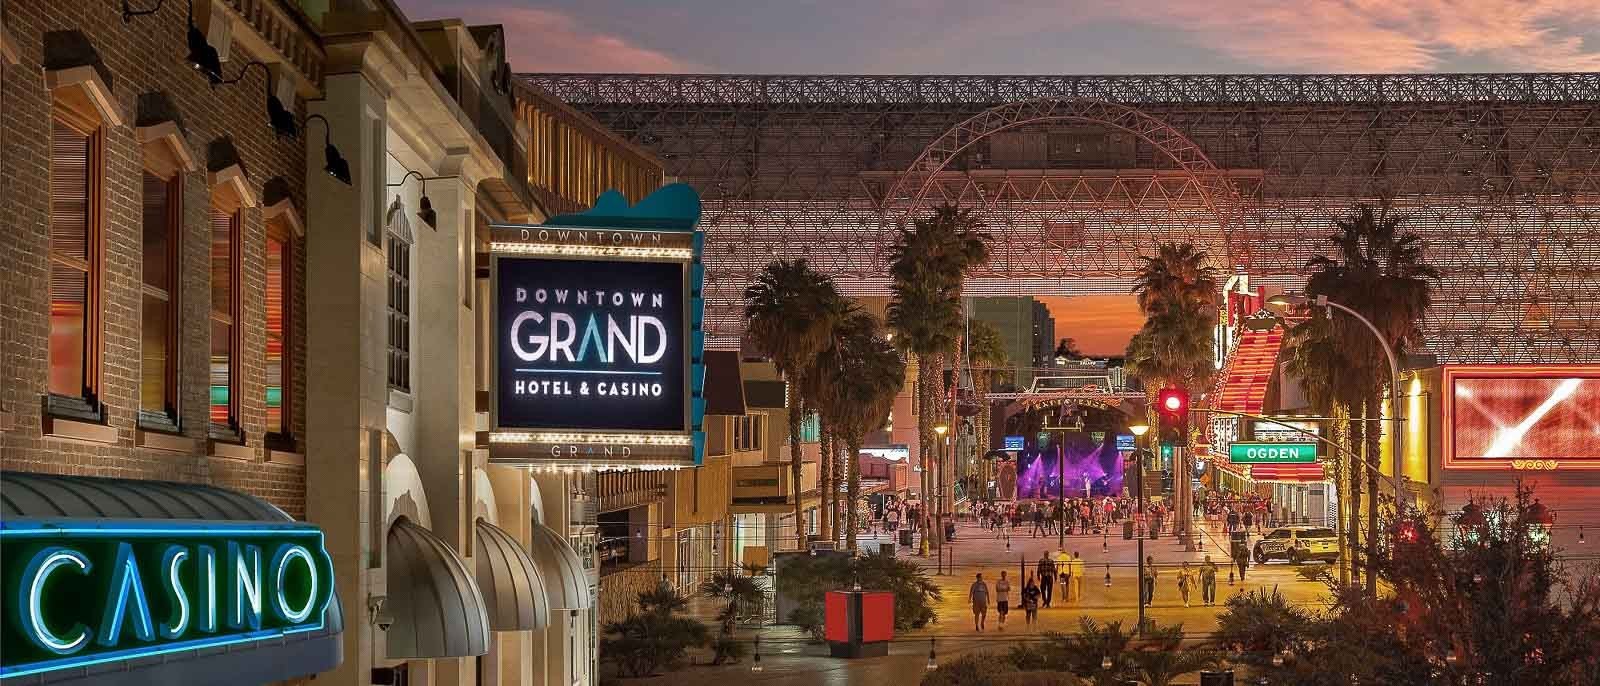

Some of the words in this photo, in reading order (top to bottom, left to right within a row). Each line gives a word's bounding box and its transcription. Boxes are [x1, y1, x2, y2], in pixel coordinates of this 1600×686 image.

[521, 229, 662, 244] DOWNTOWN
[516, 288, 663, 308] DOWNTOWN
[510, 310, 667, 364] GRAND
[516, 381, 572, 395] HOTEL
[580, 382, 590, 396] &
[598, 382, 663, 397] CASINO
[551, 445, 631, 457] GRAND
[1247, 447, 1300, 459] OGDEN
[19, 541, 318, 655] CASINO
